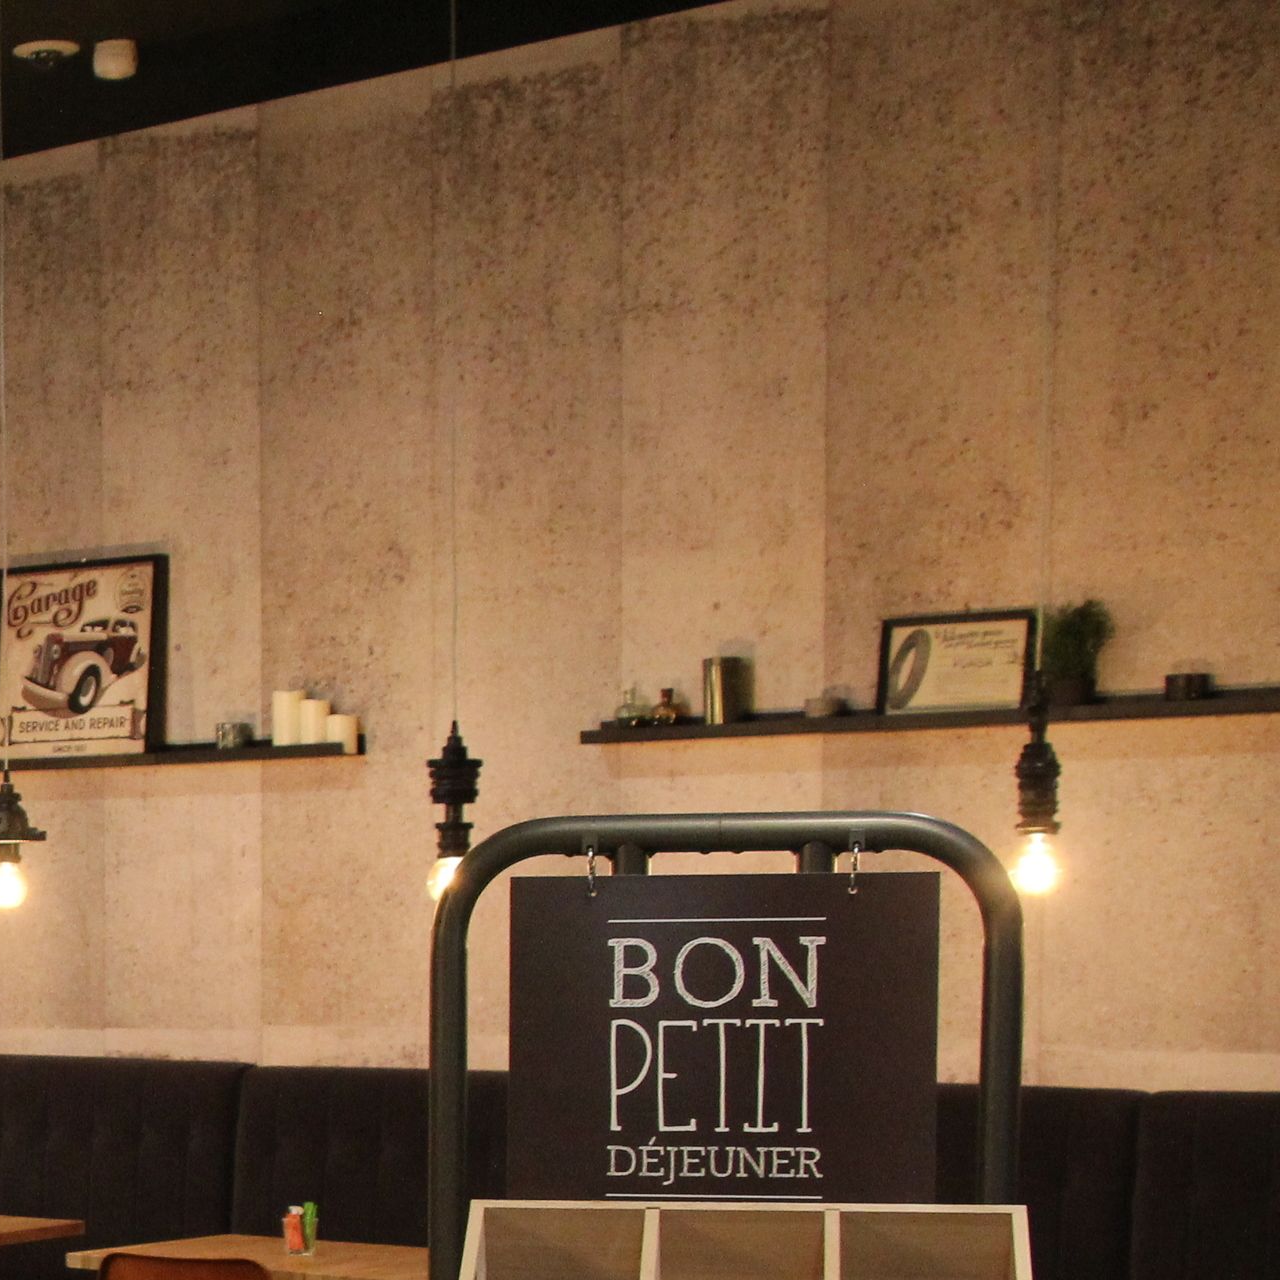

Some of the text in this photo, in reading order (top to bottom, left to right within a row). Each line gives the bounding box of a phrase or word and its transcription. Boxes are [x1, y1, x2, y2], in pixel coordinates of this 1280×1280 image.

[7, 579, 98, 628] Garage
[18, 716, 126, 733] SERVICE AND REPAIR
[608, 937, 827, 1008] BON
[609, 1018, 824, 1133] PETIT
[606, 1137, 824, 1186] DÉJEUNER
